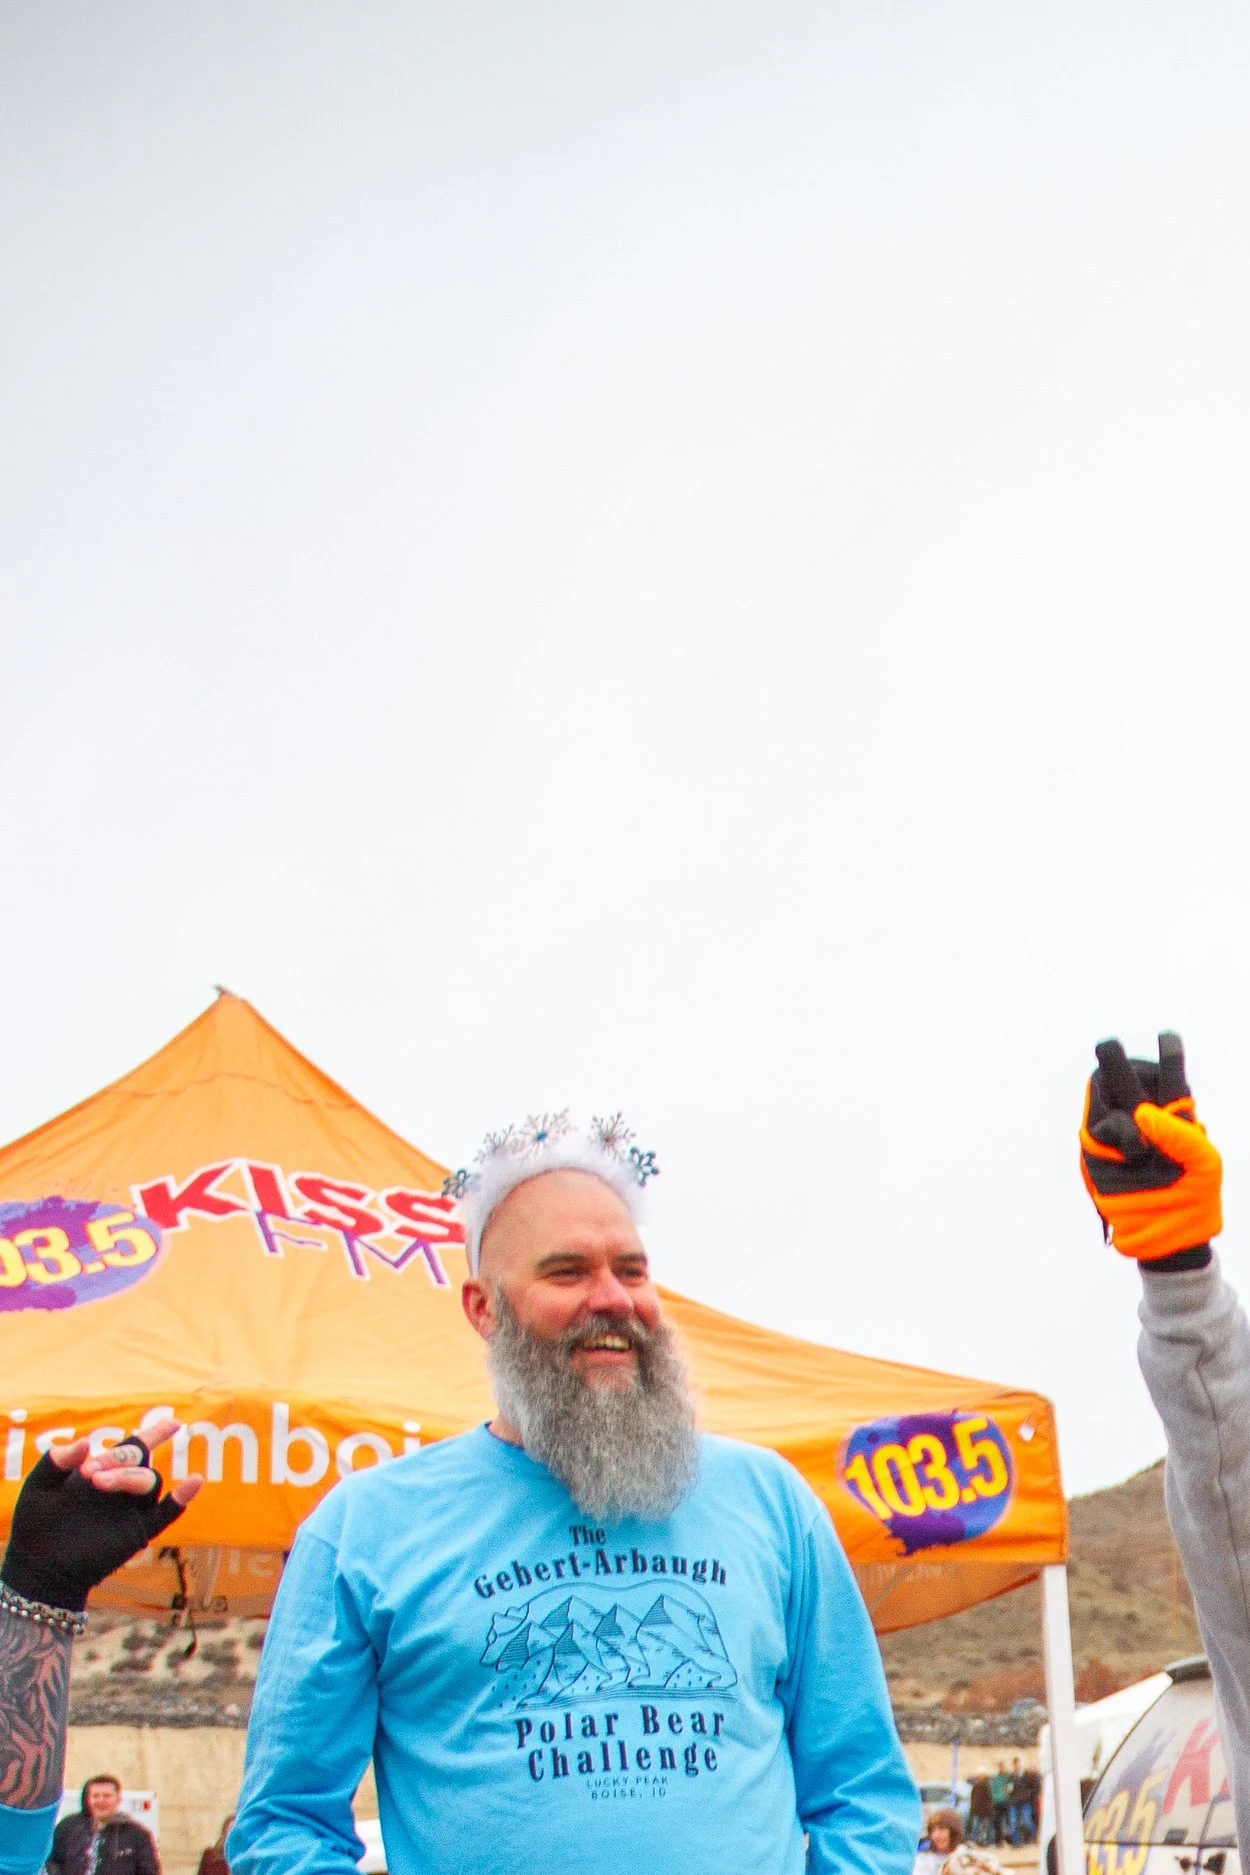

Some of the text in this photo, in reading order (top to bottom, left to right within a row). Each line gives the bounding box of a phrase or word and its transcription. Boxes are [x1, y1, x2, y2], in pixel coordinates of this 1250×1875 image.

[132, 1158, 467, 1246] KISS
[255, 1208, 451, 1289] FM
[844, 1416, 1009, 1521] 103.5
[568, 1524, 607, 1546] The
[474, 1547, 727, 1600] Gebert-Arbaugh
[515, 1703, 725, 1749] Polar Bear
[528, 1739, 718, 1782] Challenge
